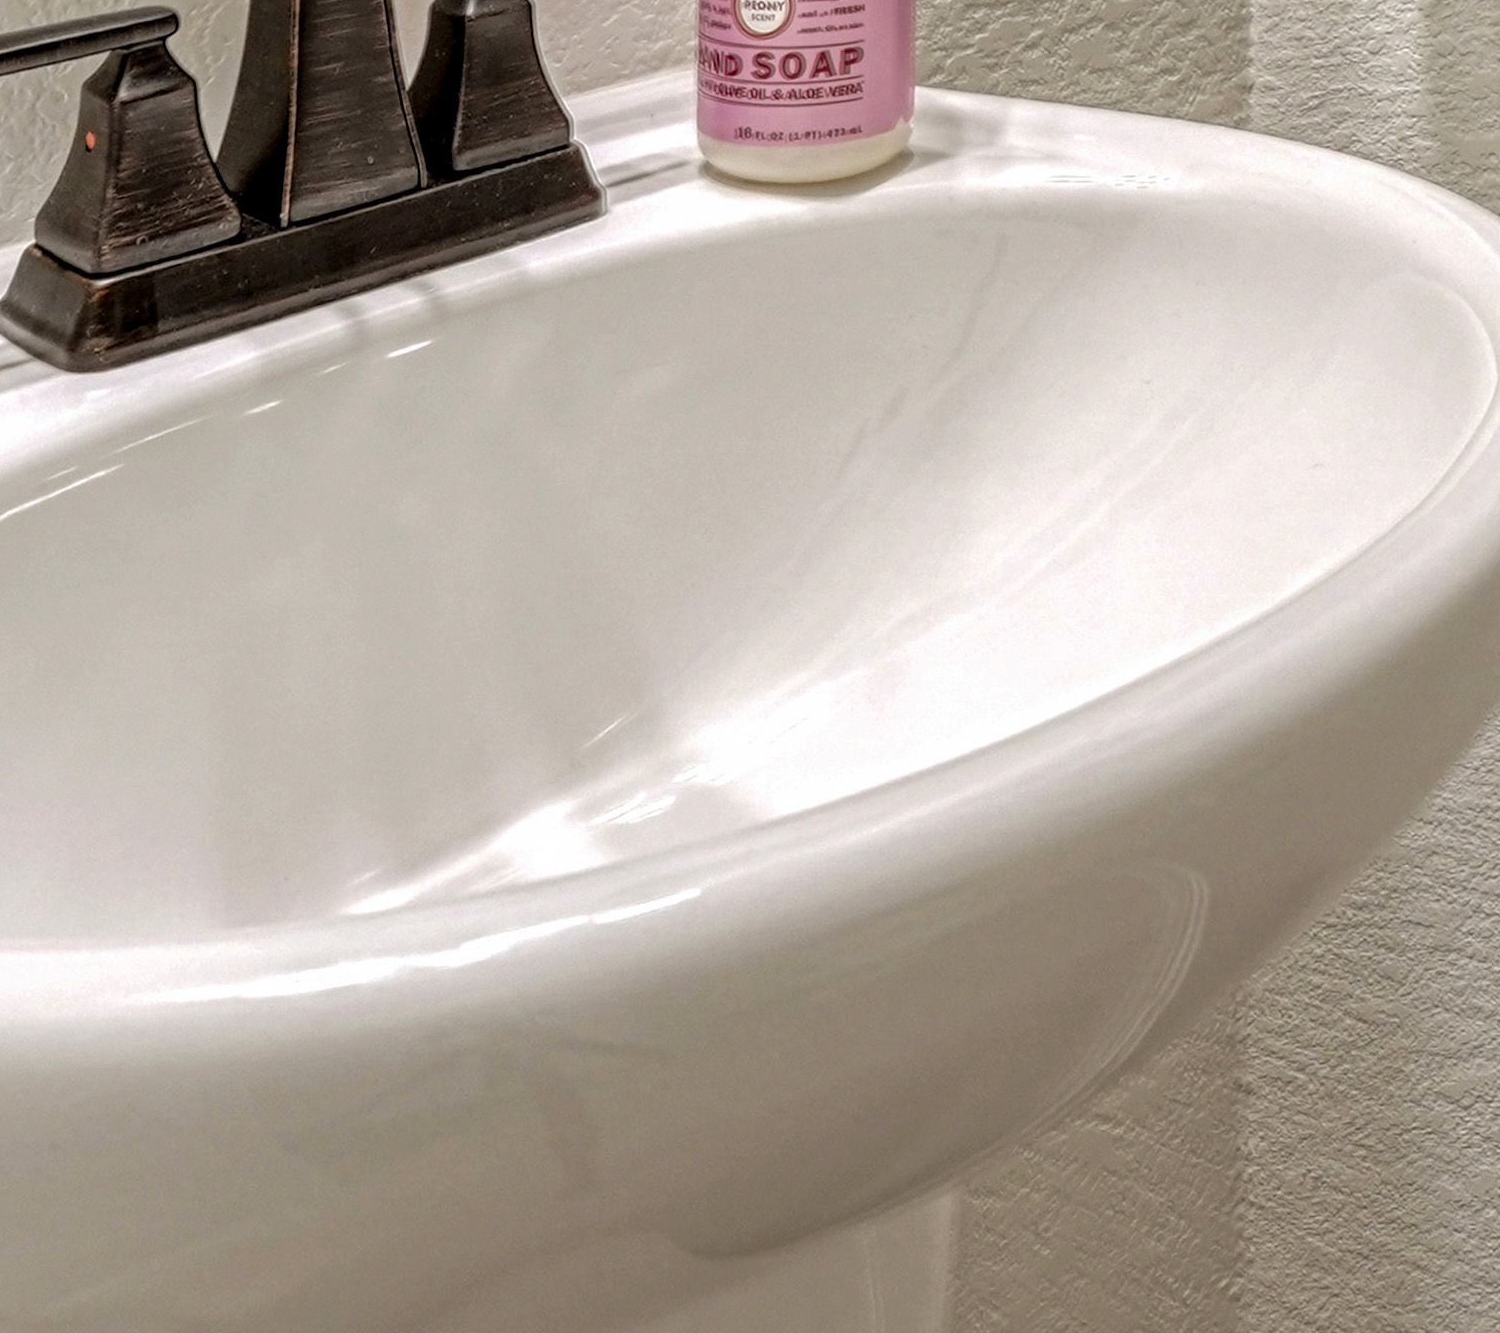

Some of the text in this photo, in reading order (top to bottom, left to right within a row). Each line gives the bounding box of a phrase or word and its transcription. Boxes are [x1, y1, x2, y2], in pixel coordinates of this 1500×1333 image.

[751, 13, 776, 22] SCENT
[699, 46, 865, 80] AND SOAP
